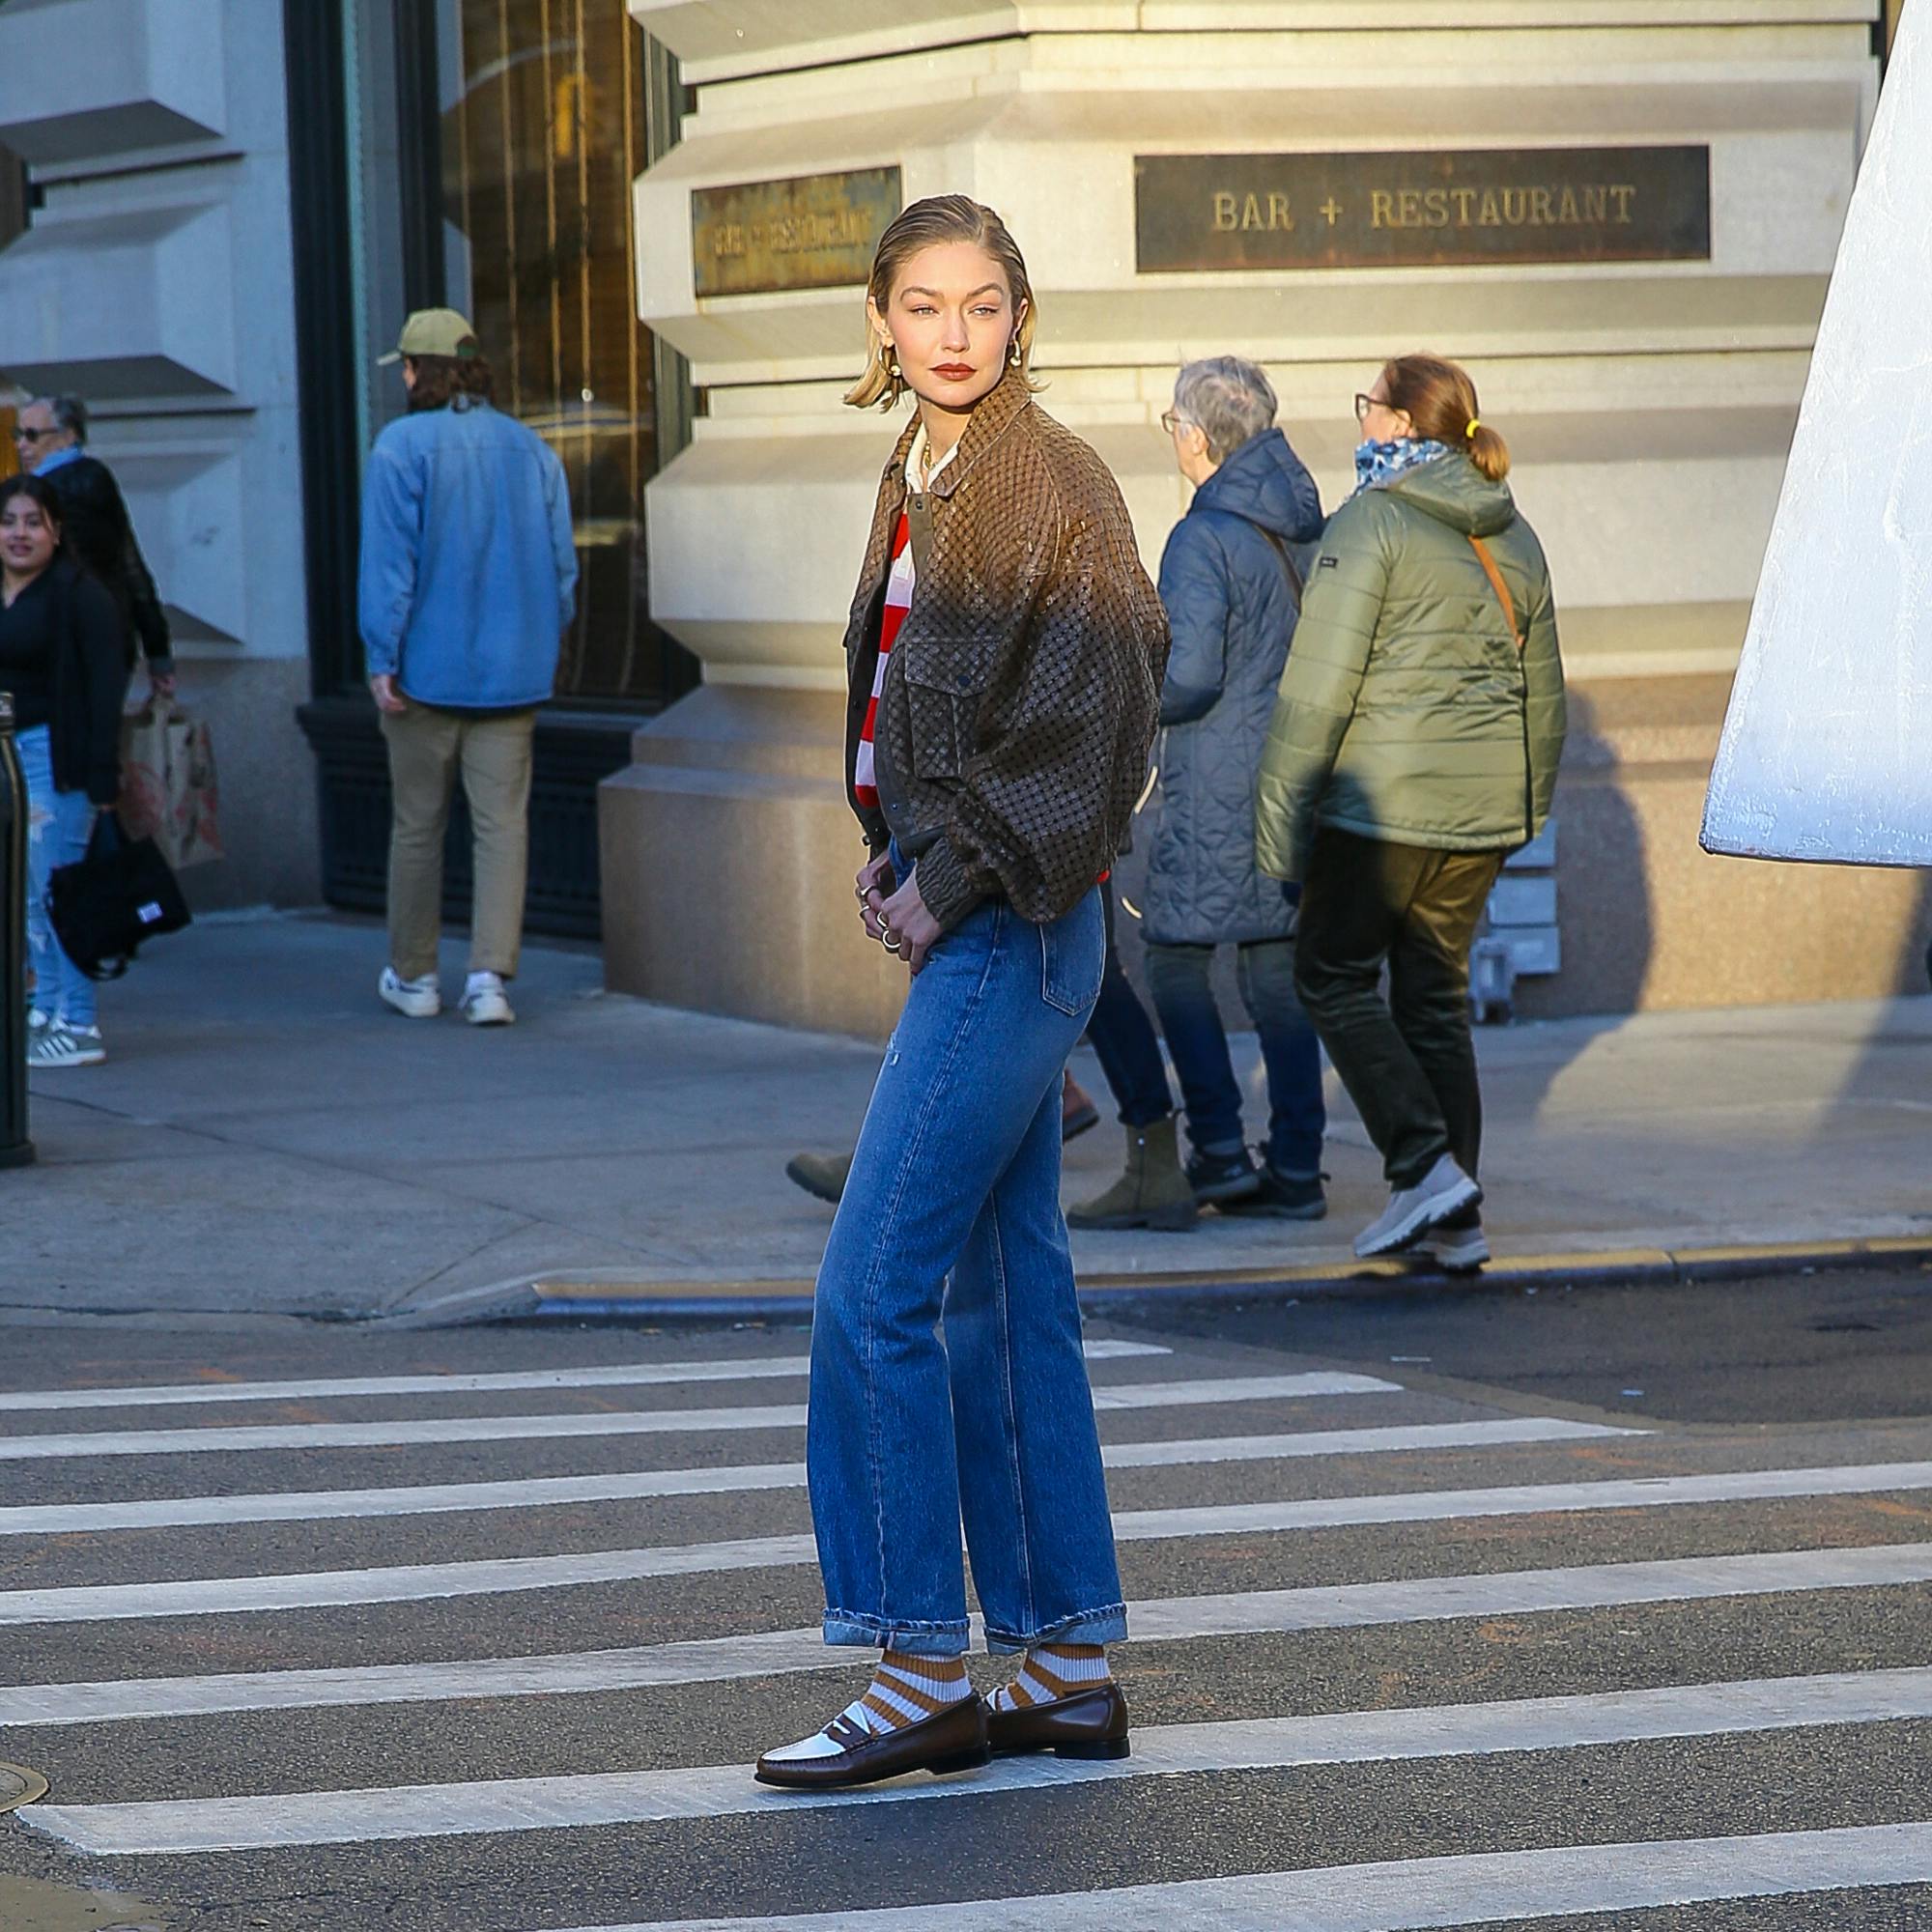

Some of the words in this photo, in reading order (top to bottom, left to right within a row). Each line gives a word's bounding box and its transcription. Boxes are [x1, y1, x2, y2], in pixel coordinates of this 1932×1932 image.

[1212, 191, 1294, 232] BAR
[1319, 197, 1343, 227] +
[1370, 184, 1636, 230] RESTAURANT
